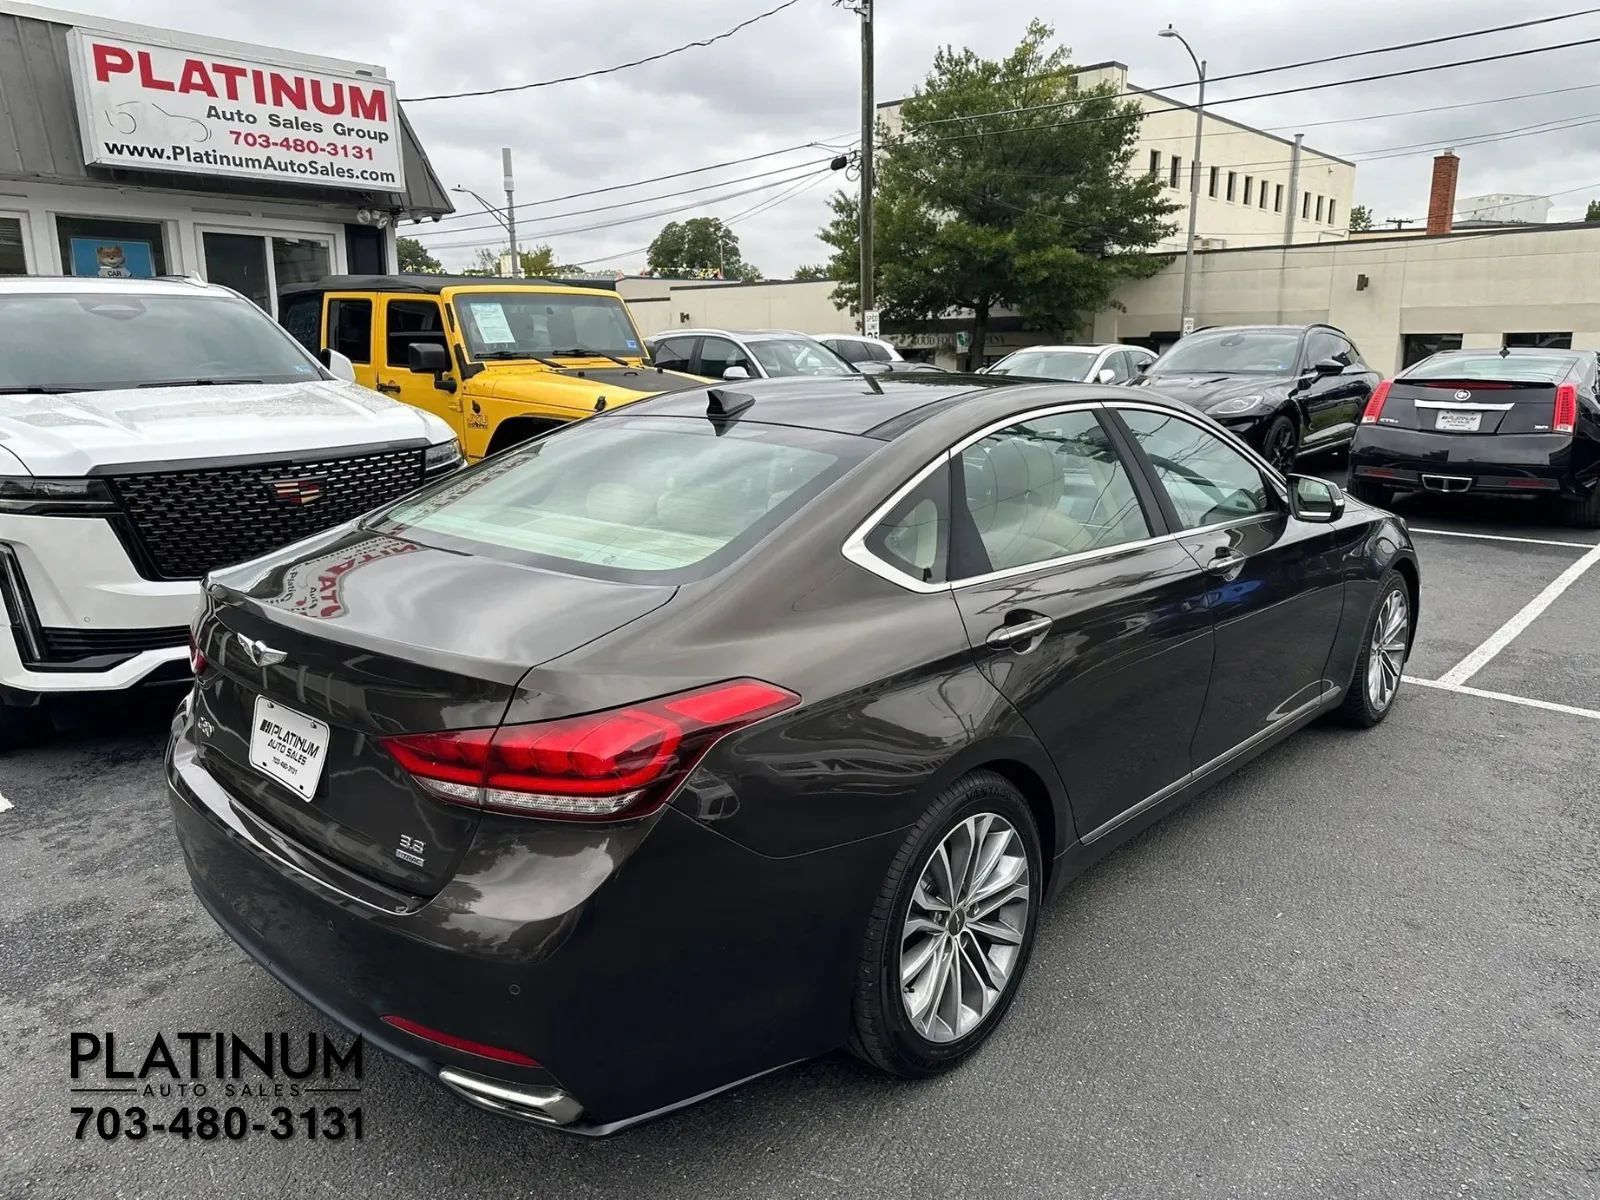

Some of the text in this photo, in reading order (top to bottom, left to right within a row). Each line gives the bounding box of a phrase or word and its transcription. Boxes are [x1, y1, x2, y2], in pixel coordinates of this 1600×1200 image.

[91, 43, 388, 122] PLATINUM
[206, 105, 389, 144] Auto Sales Group
[104, 141, 396, 183] www.PlatinumAutoSales.com
[229, 130, 374, 161] 703-480-3131
[267, 739, 308, 766] AUTO SALES
[271, 724, 320, 759] PLATINUM
[399, 834, 424, 854] 3.8
